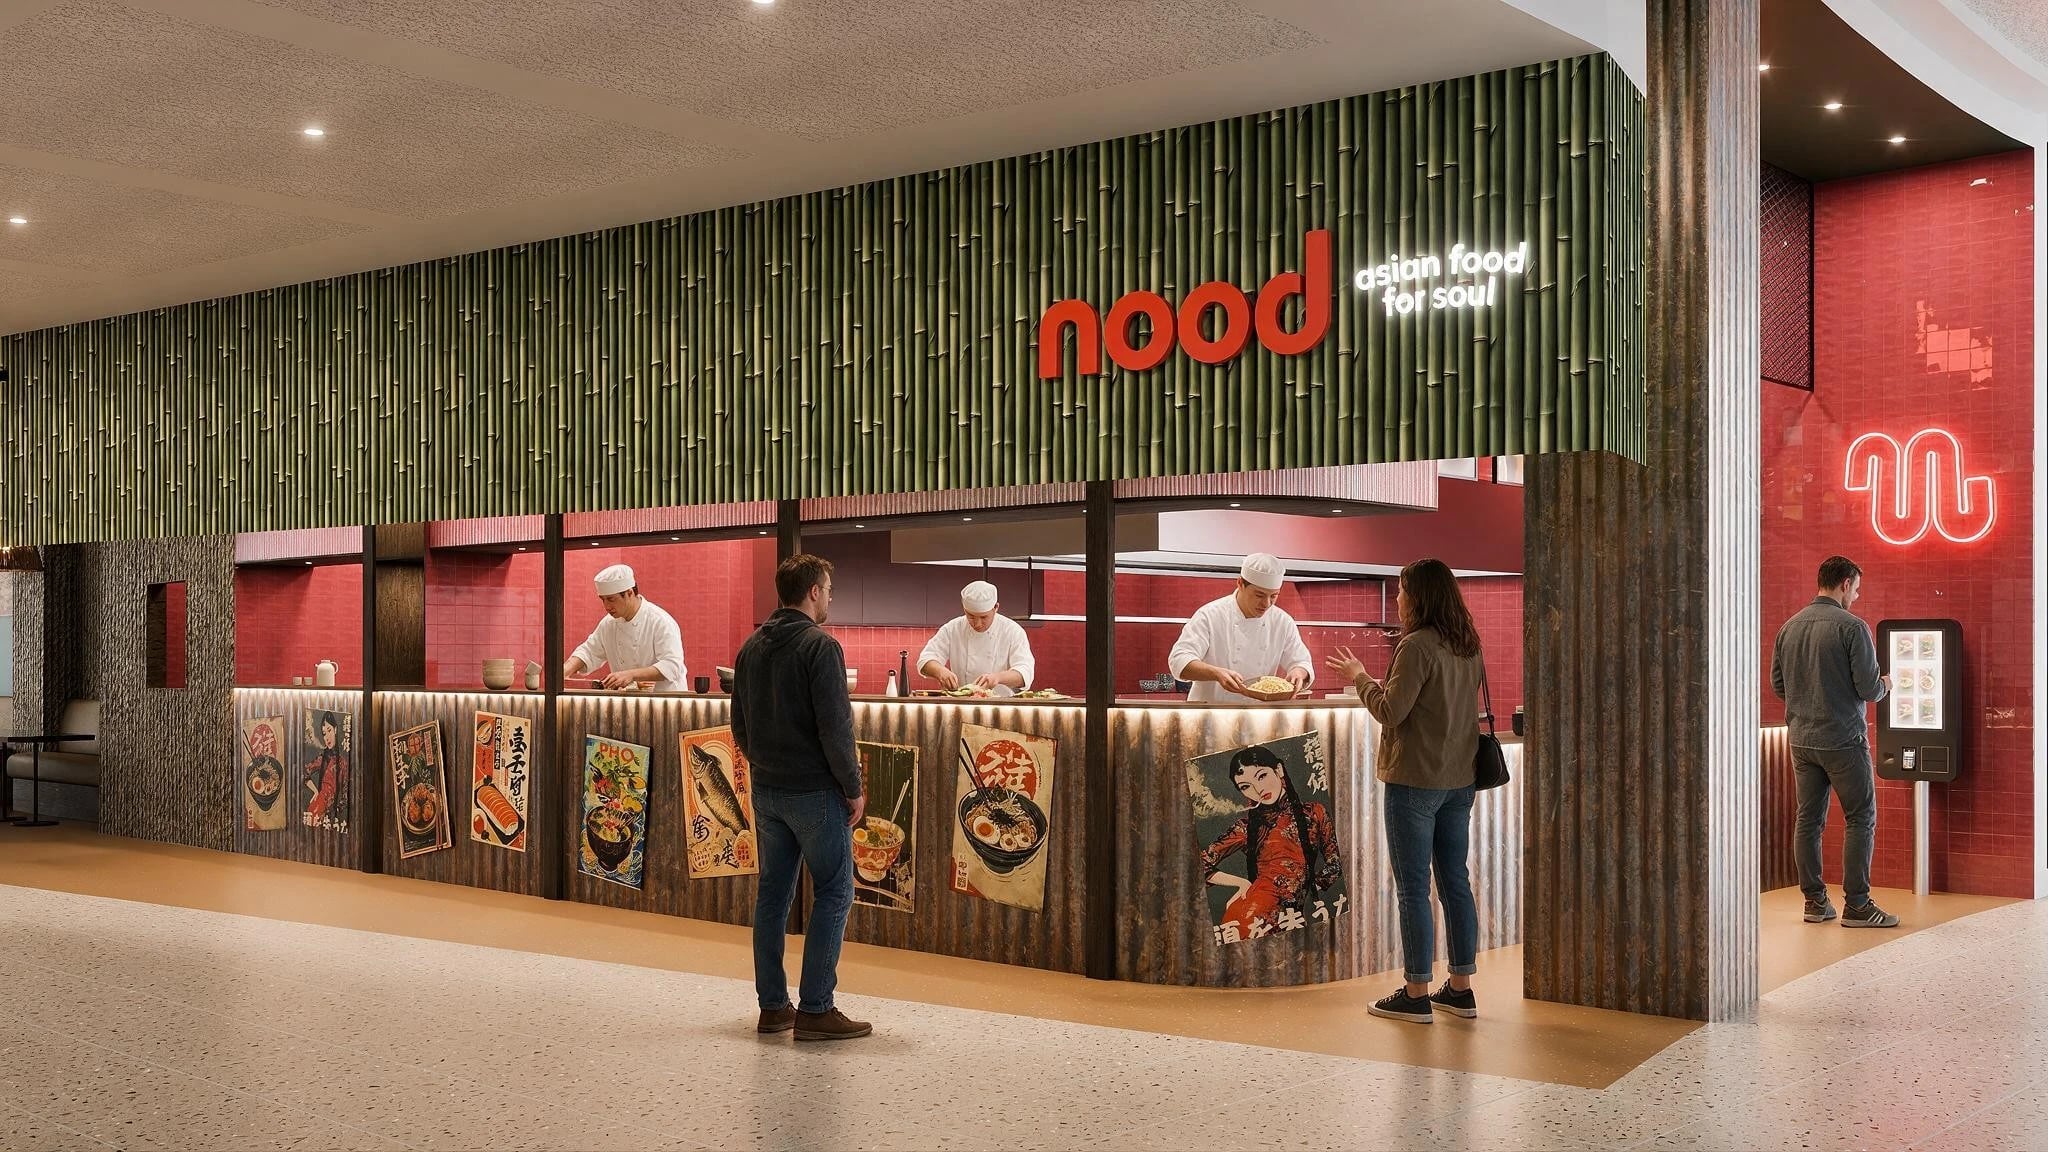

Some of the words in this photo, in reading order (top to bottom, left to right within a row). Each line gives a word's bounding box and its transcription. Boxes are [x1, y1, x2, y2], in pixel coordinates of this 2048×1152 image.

[1355, 254, 1440, 290] asian
[1448, 242, 1528, 274] food
[1039, 229, 1332, 379] nood
[1382, 286, 1426, 317] for
[1432, 276, 1496, 309] soul
[599, 742, 635, 765] PHO
